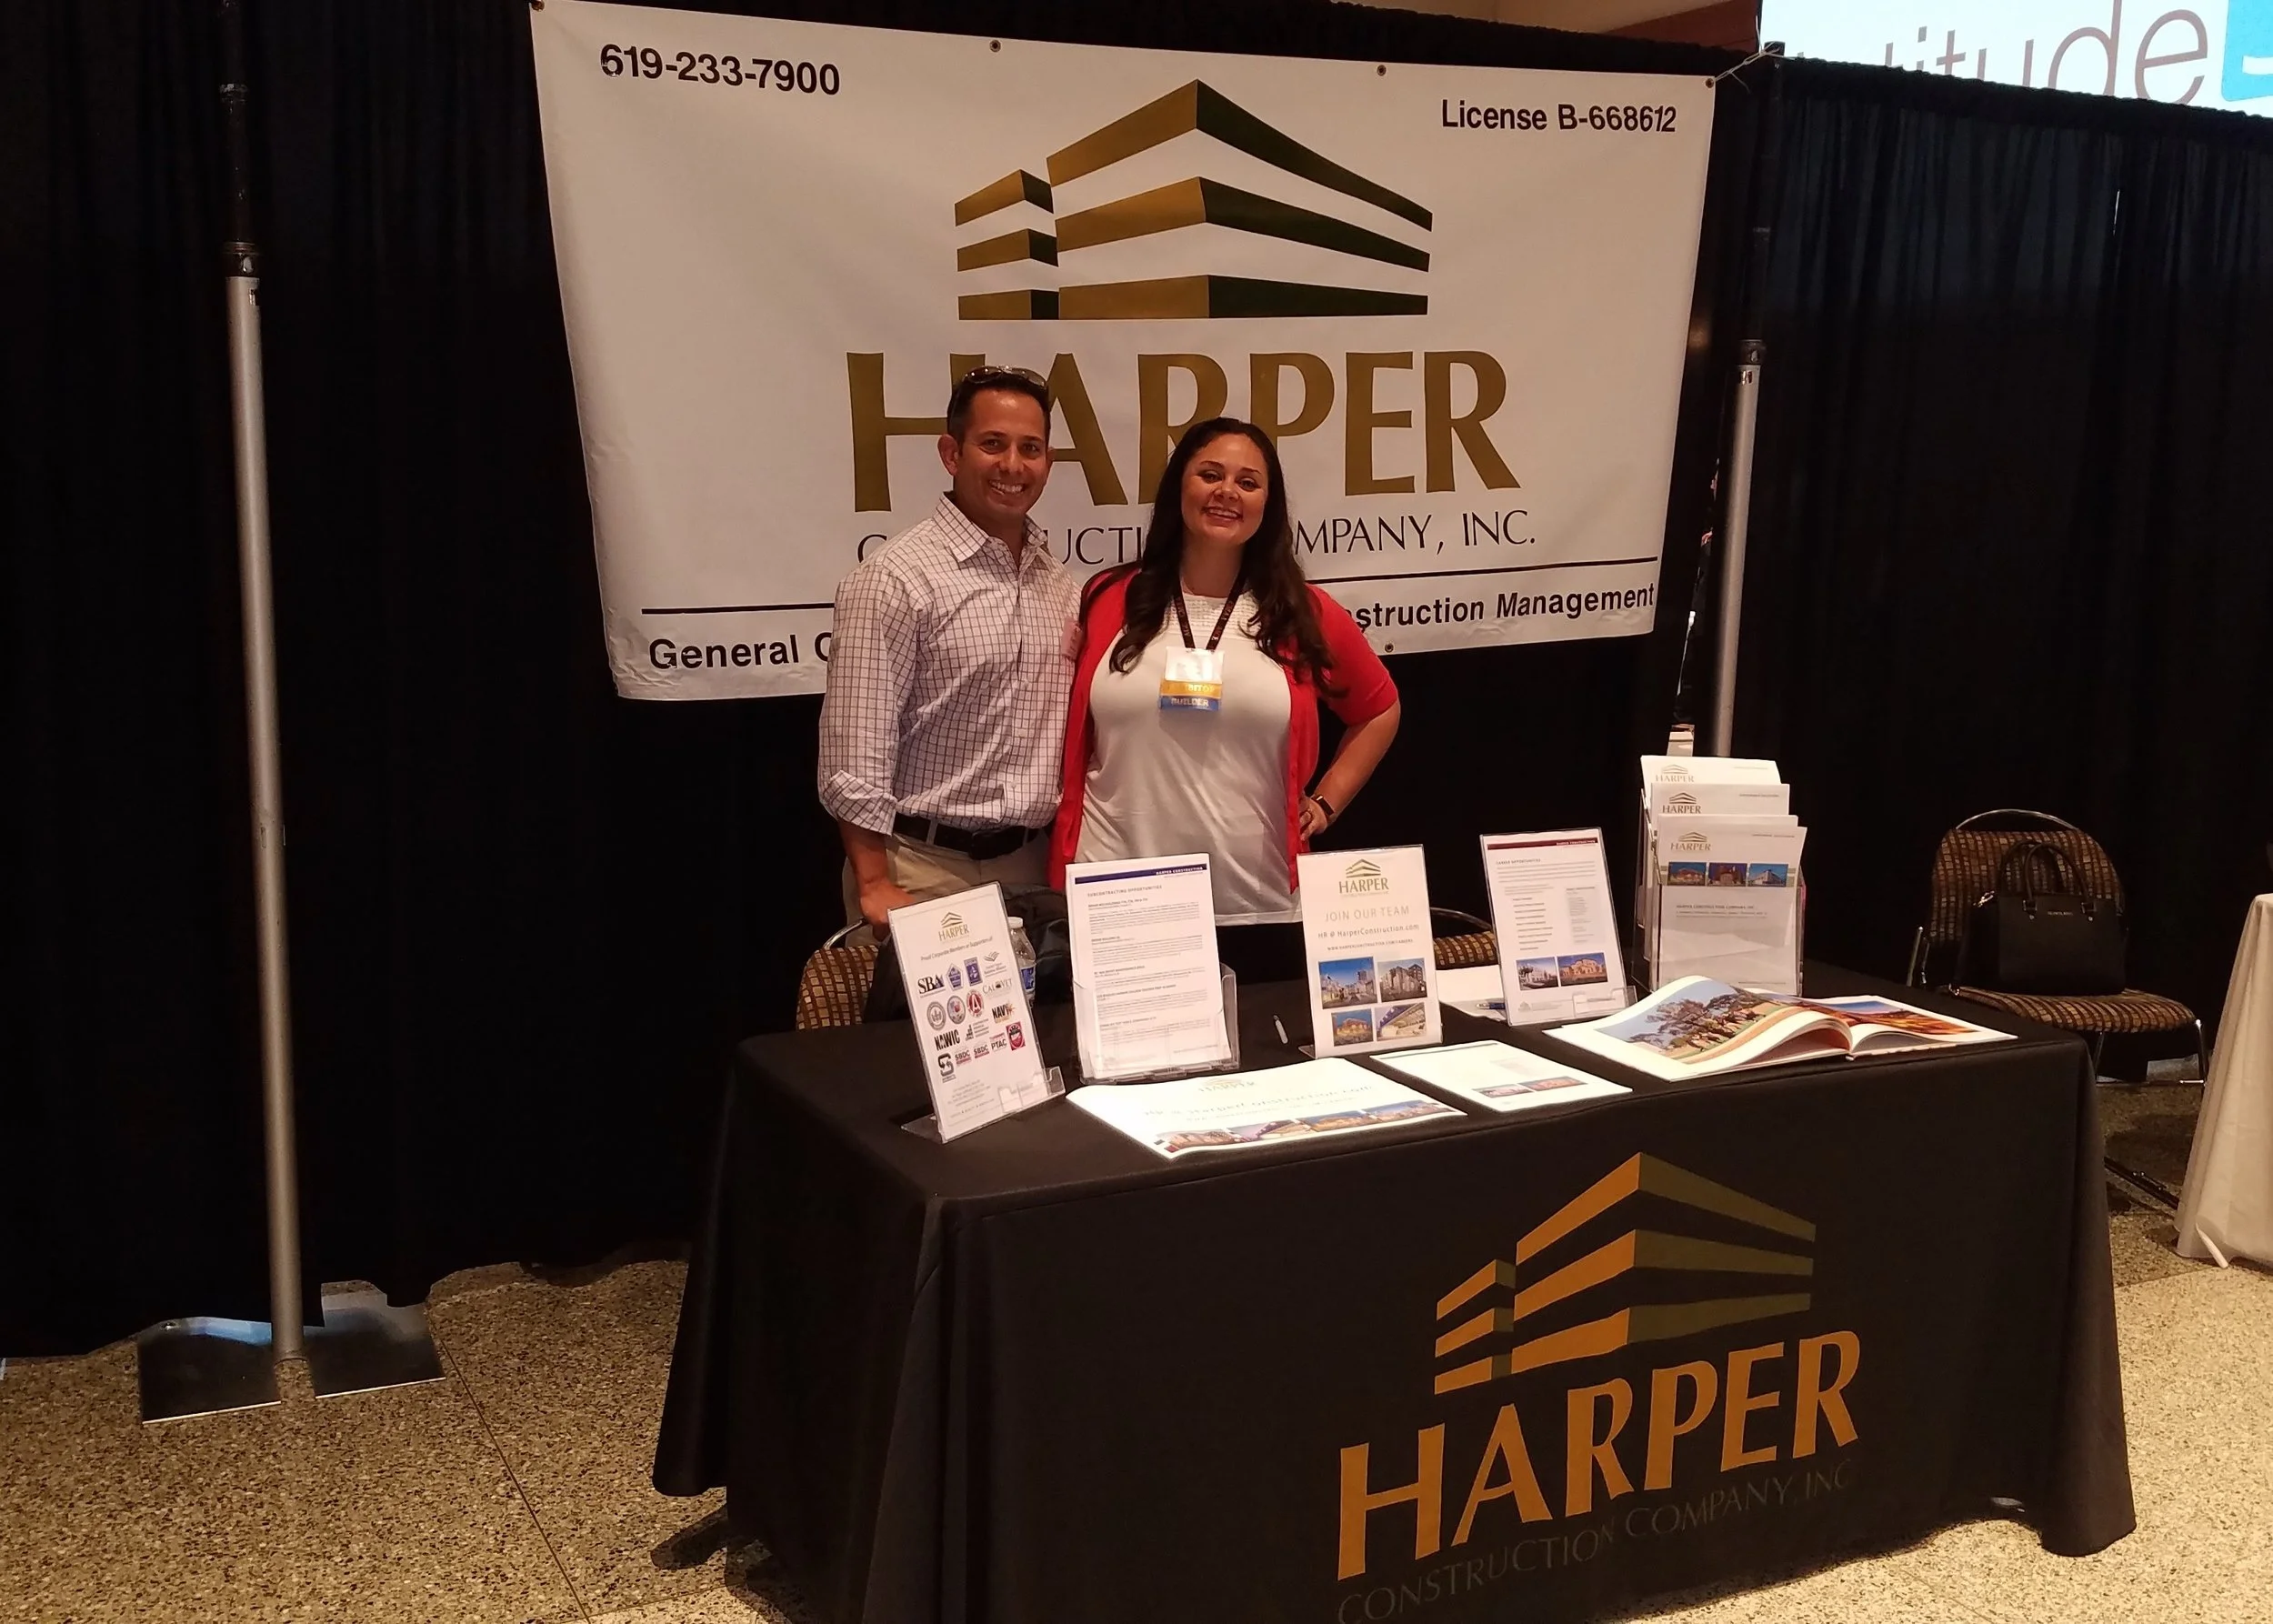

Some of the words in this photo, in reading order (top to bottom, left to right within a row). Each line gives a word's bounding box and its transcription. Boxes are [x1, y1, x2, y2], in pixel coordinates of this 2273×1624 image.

[600, 44, 840, 95] 619-233-7900
[1442, 99, 1547, 130] License
[1557, 104, 1677, 133] B-668612
[846, 350, 1522, 513] HARPER
[1295, 514, 1445, 555] MPANY,
[1462, 509, 1537, 546] INC.
[1347, 597, 1485, 629] struction
[1496, 582, 1655, 619] Management
[649, 635, 799, 669] General
[1656, 774, 1695, 783] HARPER
[1662, 805, 1701, 814] HARPER
[1670, 843, 1711, 851] HARPER
[1338, 877, 1389, 894] HARPER
[1326, 910, 1349, 922] JOIN
[1354, 907, 1377, 920] OUR
[1380, 905, 1409, 917] TEAM
[938, 924, 969, 941] HARPER
[1337, 924, 1419, 937] HarperConstruction.com
[917, 975, 945, 995] SBA
[992, 1003, 1010, 1019] NAVY
[934, 1029, 961, 1051] NAWIC
[991, 1038, 1006, 1050] PTAC
[955, 1050, 970, 1061] SBDC
[1337, 1330, 1861, 1580] HARPER
[1337, 1517, 1616, 1623] CONSTRUCTION
